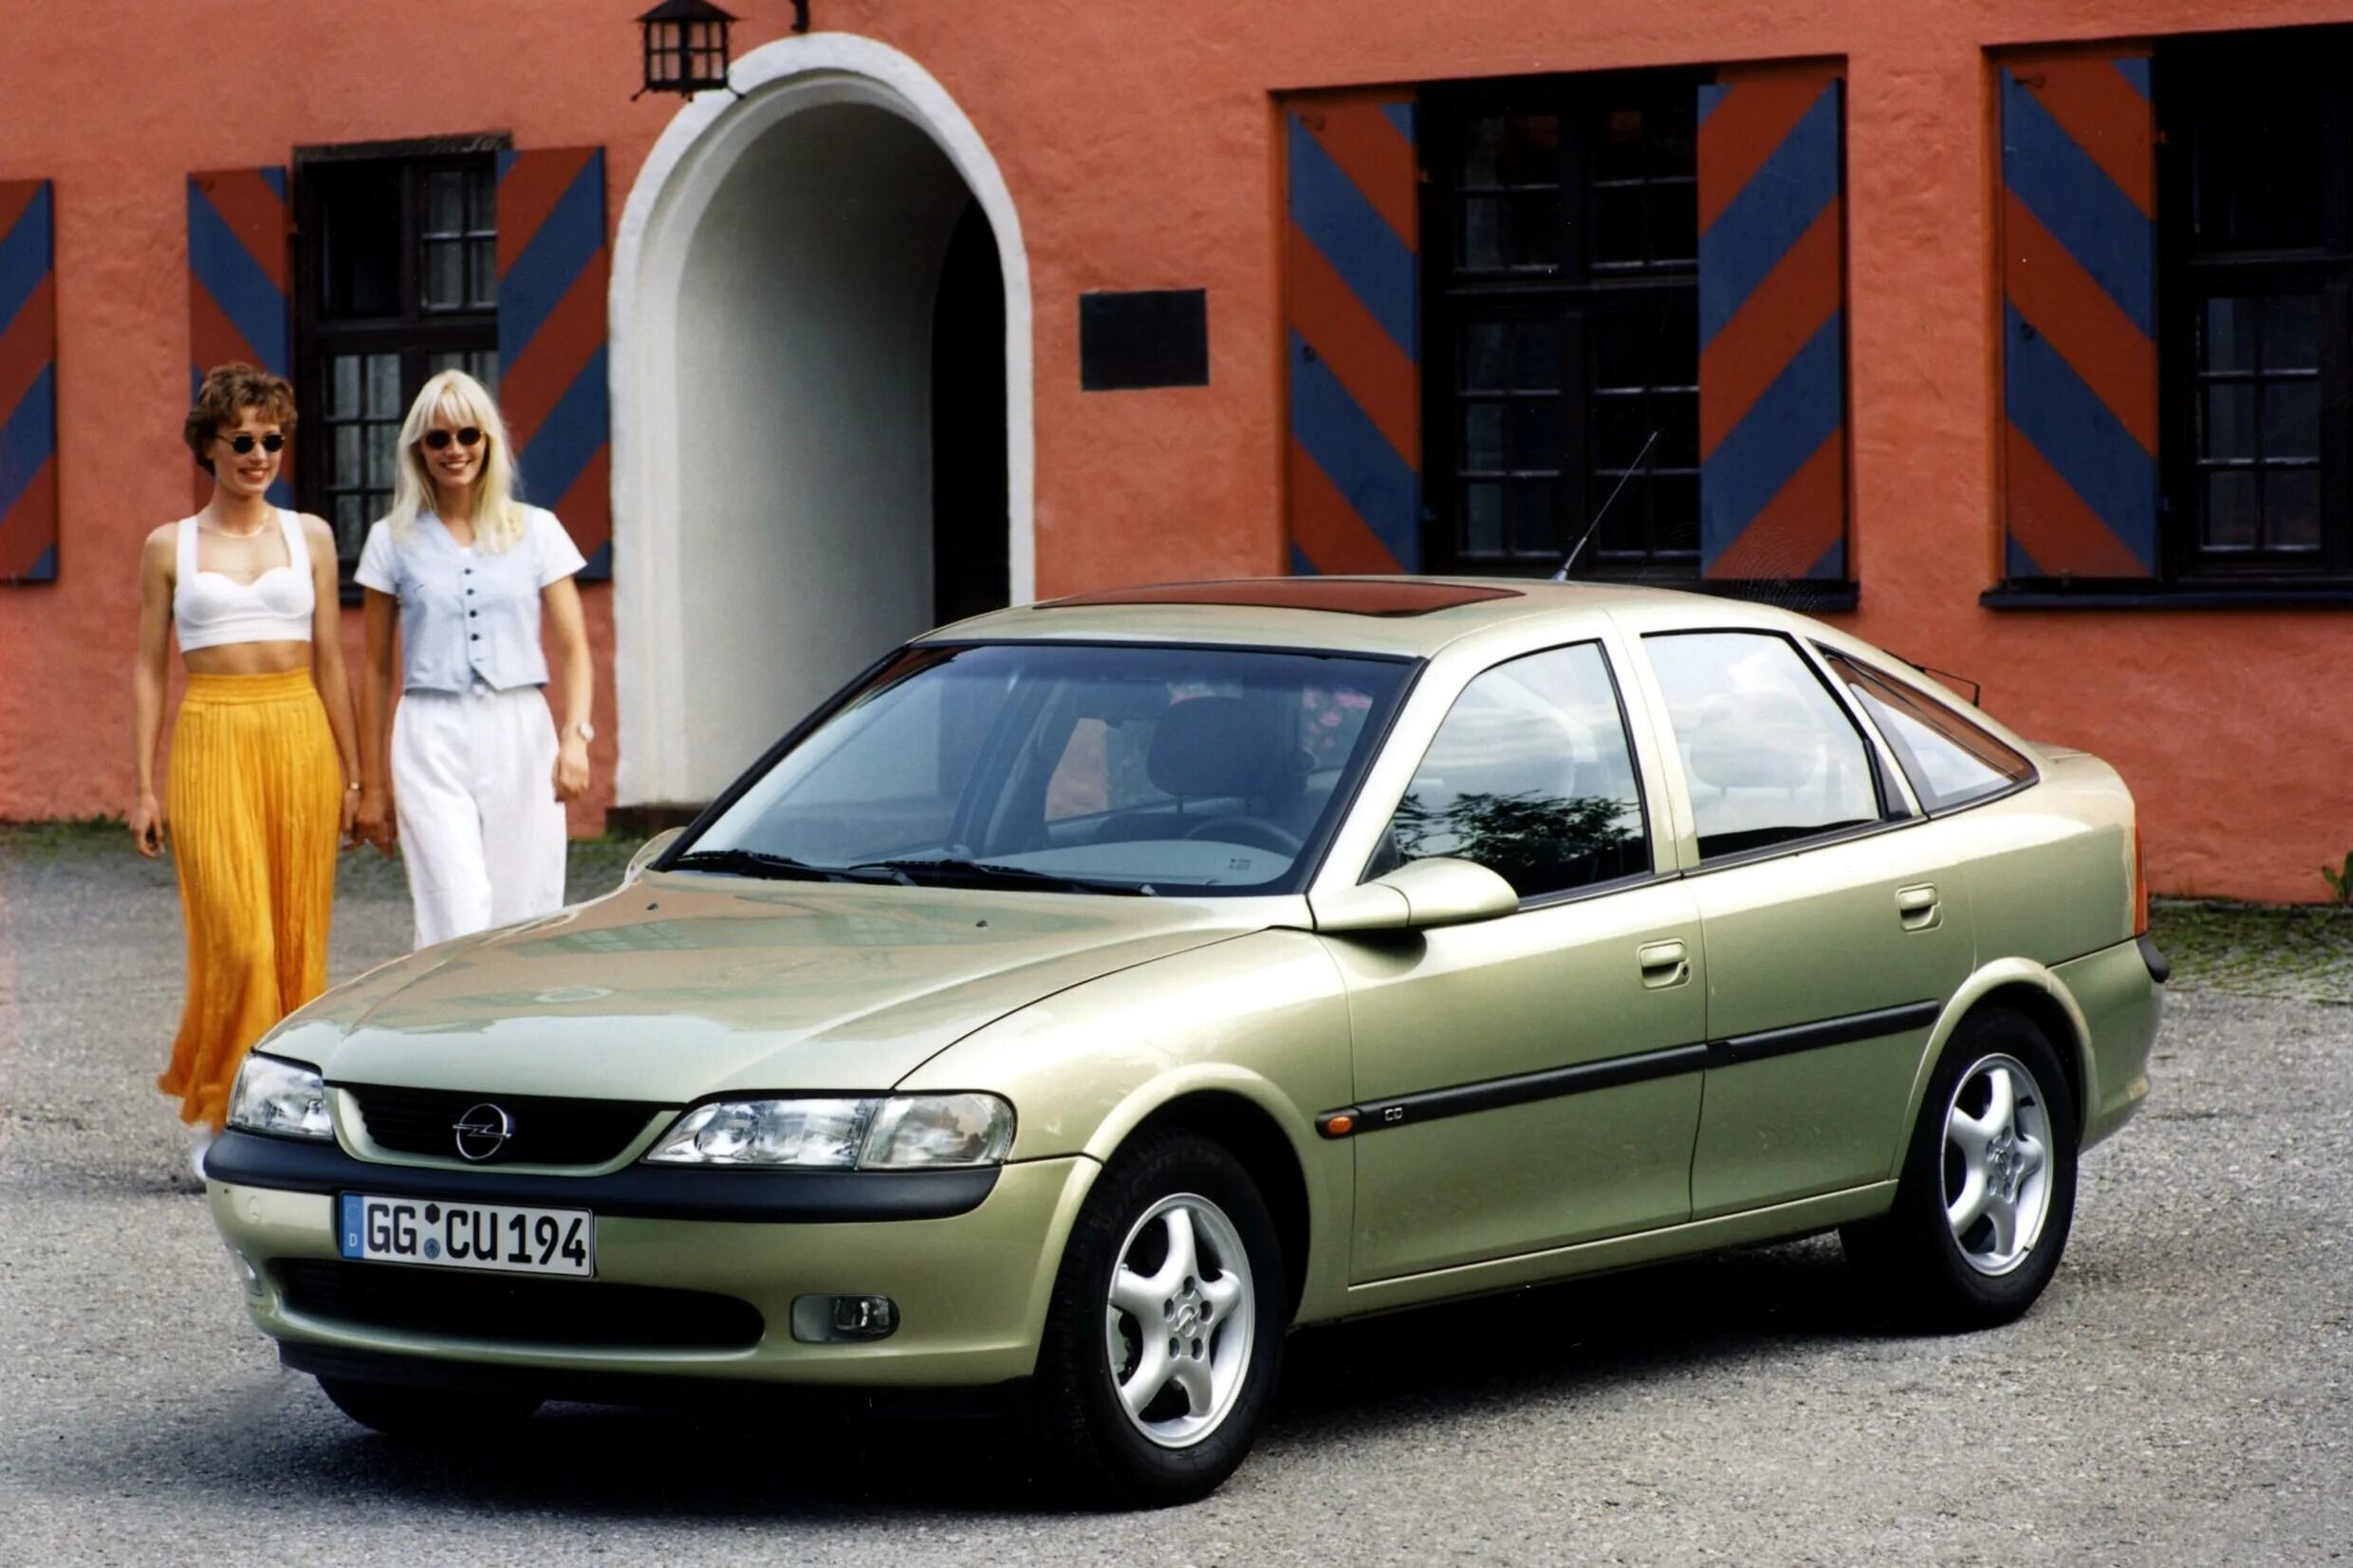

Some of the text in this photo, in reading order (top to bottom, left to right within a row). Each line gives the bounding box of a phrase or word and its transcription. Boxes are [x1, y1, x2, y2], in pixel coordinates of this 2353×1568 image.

[348, 1233, 358, 1246] D
[366, 1203, 586, 1267] GG CU 194
